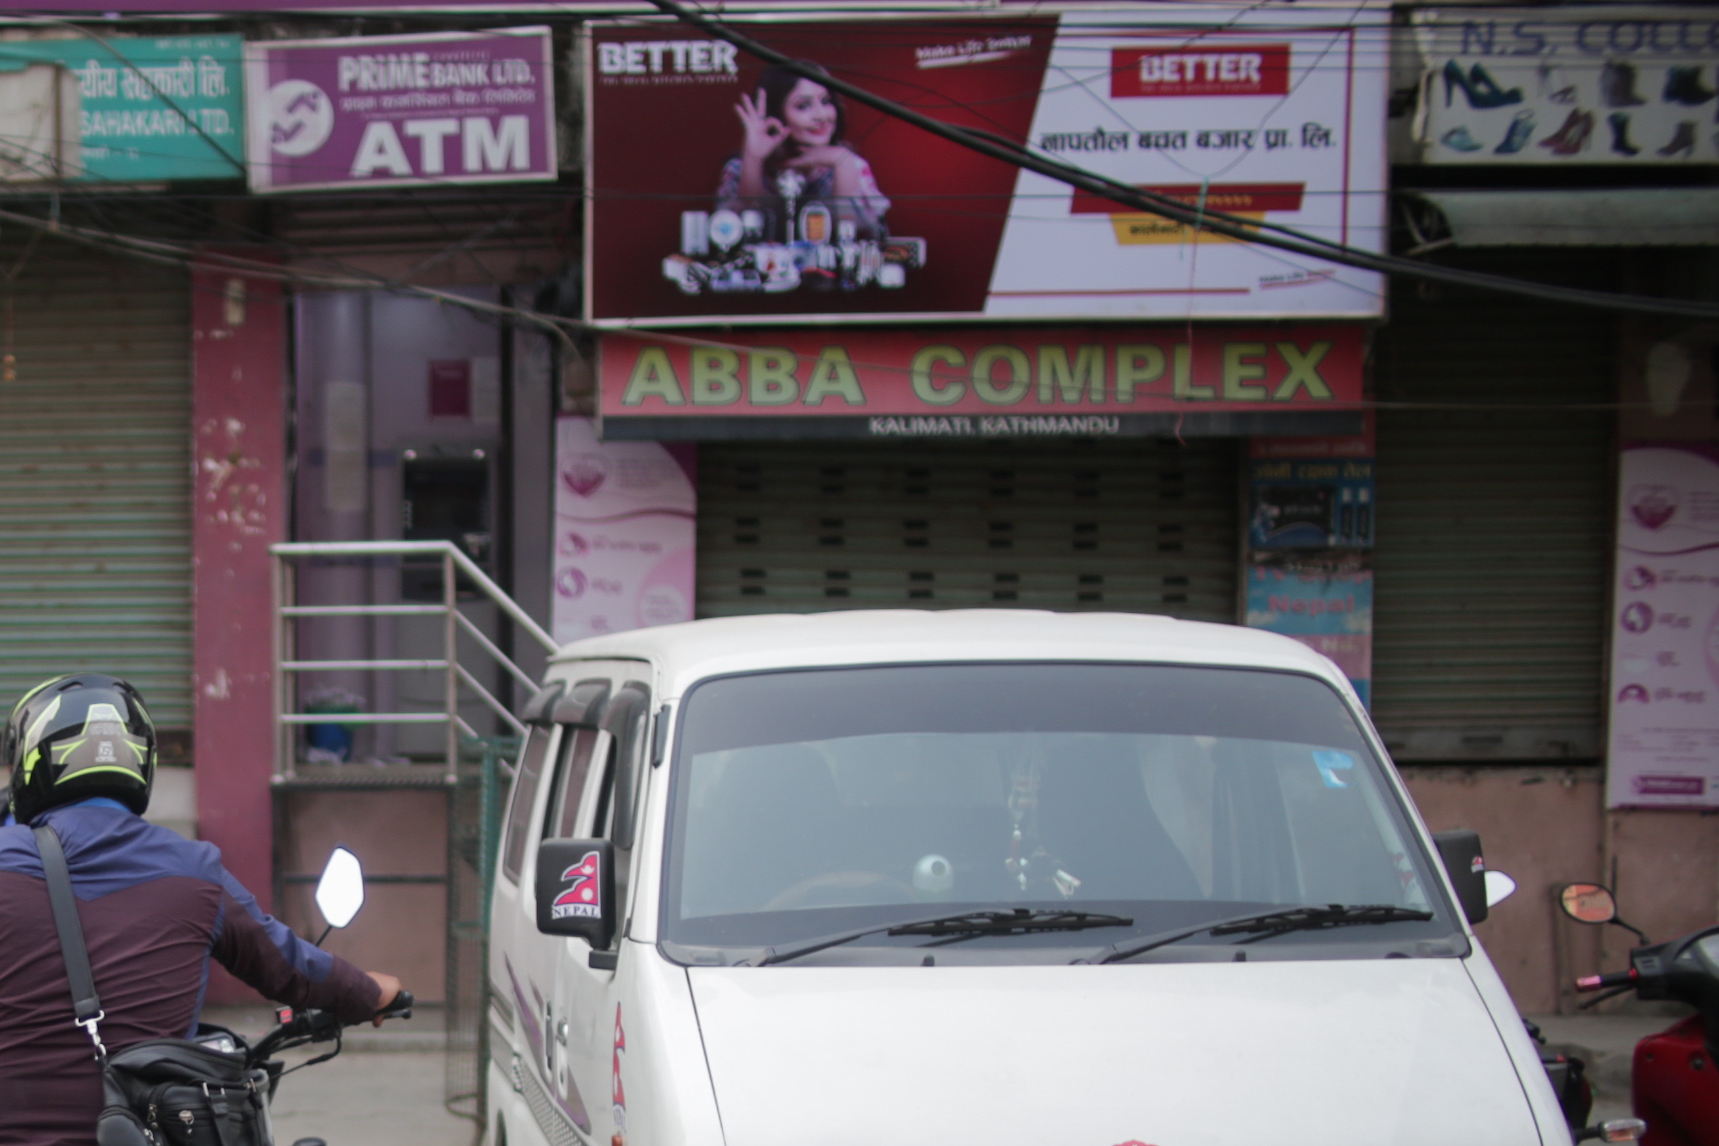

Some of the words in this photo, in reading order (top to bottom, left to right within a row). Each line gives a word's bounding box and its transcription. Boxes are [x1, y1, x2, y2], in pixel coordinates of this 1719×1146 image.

[433, 62, 490, 87] BANK
[492, 58, 536, 85] LTD.
[598, 41, 738, 74] BETTER
[1139, 54, 1262, 84] BETTER
[349, 115, 531, 178] ATM
[1040, 125, 1129, 151] नापतौल
[1138, 129, 1187, 150] बचत
[1196, 128, 1257, 150] बजार
[1300, 121, 1337, 150] लि.
[622, 345, 866, 407] ABBA
[909, 341, 1336, 406] COMPLEX
[980, 415, 1120, 435] KATHMANDU
[553, 905, 600, 917] NEPAL
